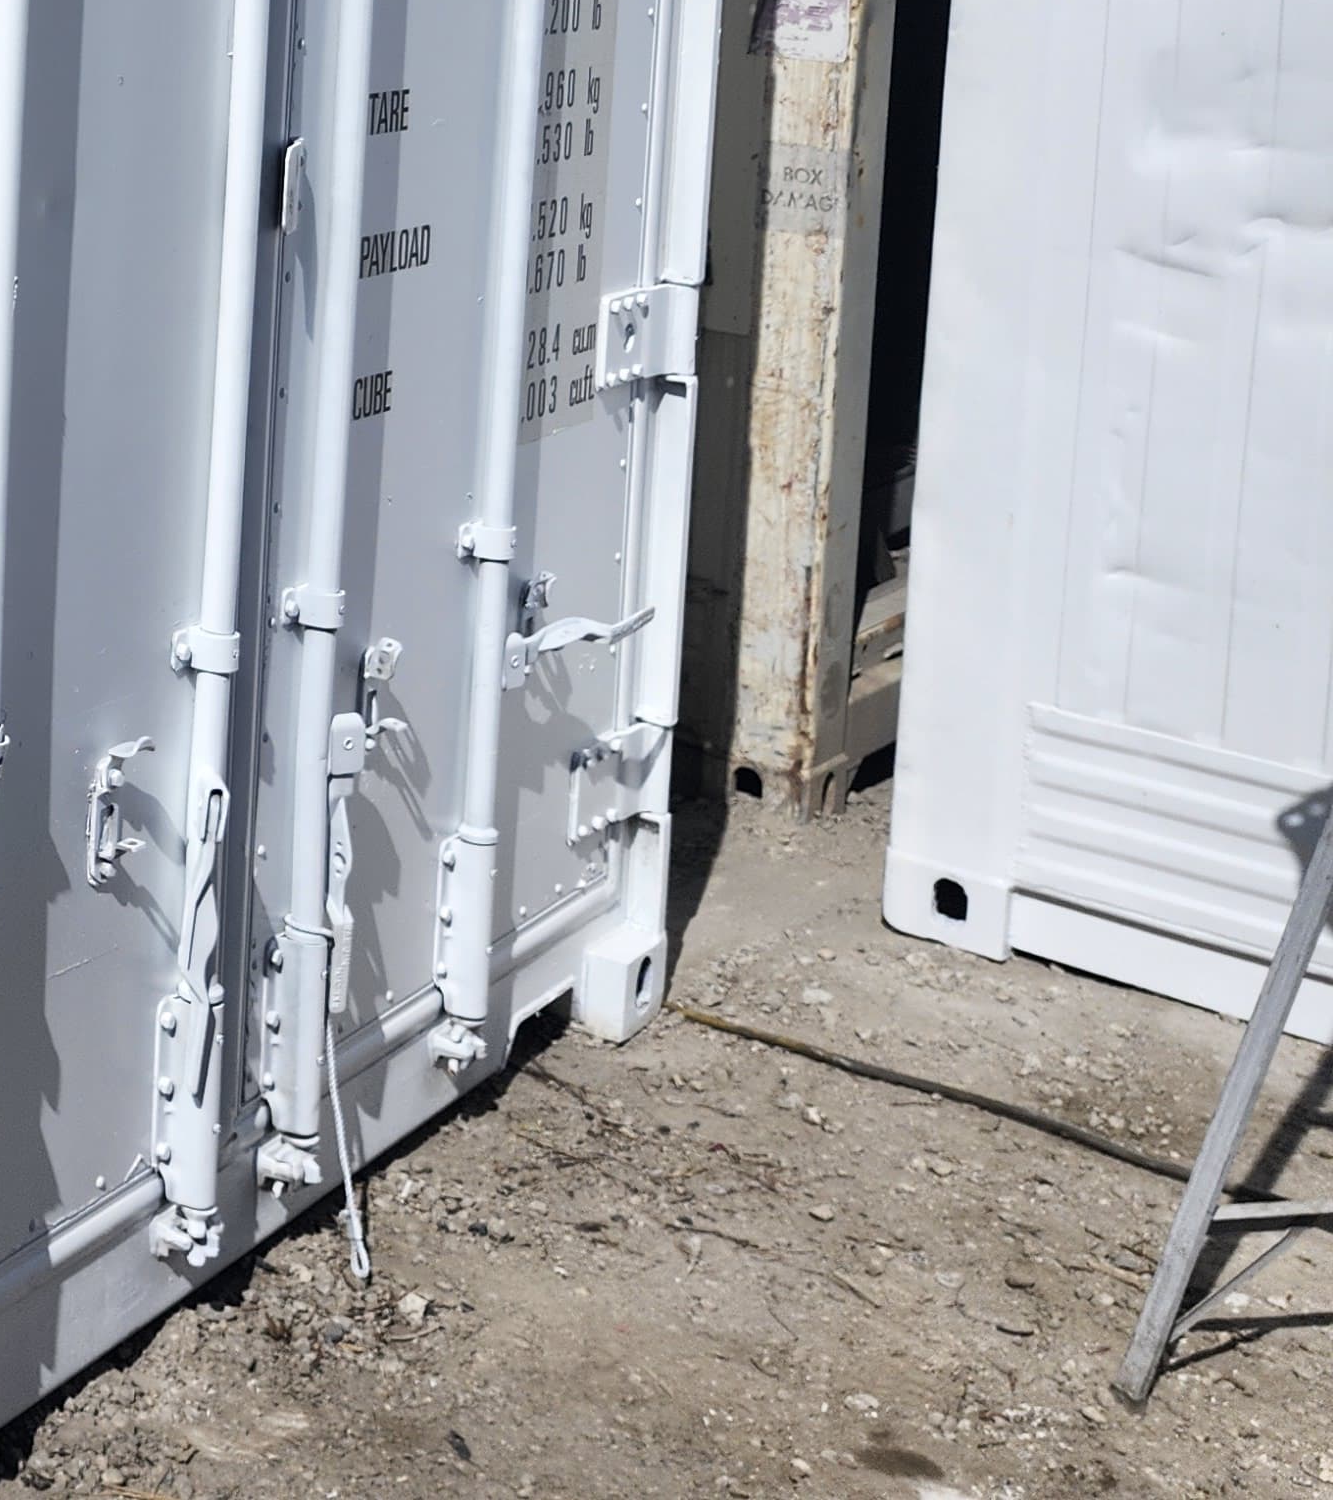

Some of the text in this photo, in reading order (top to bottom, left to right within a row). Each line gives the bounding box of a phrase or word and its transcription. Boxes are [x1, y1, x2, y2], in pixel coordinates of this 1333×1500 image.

[368, 88, 410, 136] TARE
[586, 66, 600, 115] kg
[536, 118, 594, 166] .530 lb
[531, 192, 593, 242] .520 kg
[359, 224, 431, 280] PAYLOAD
[527, 243, 587, 295] .670 lb
[527, 323, 561, 371] 28.4
[352, 370, 393, 421] CUBE
[520, 375, 558, 423] .003
